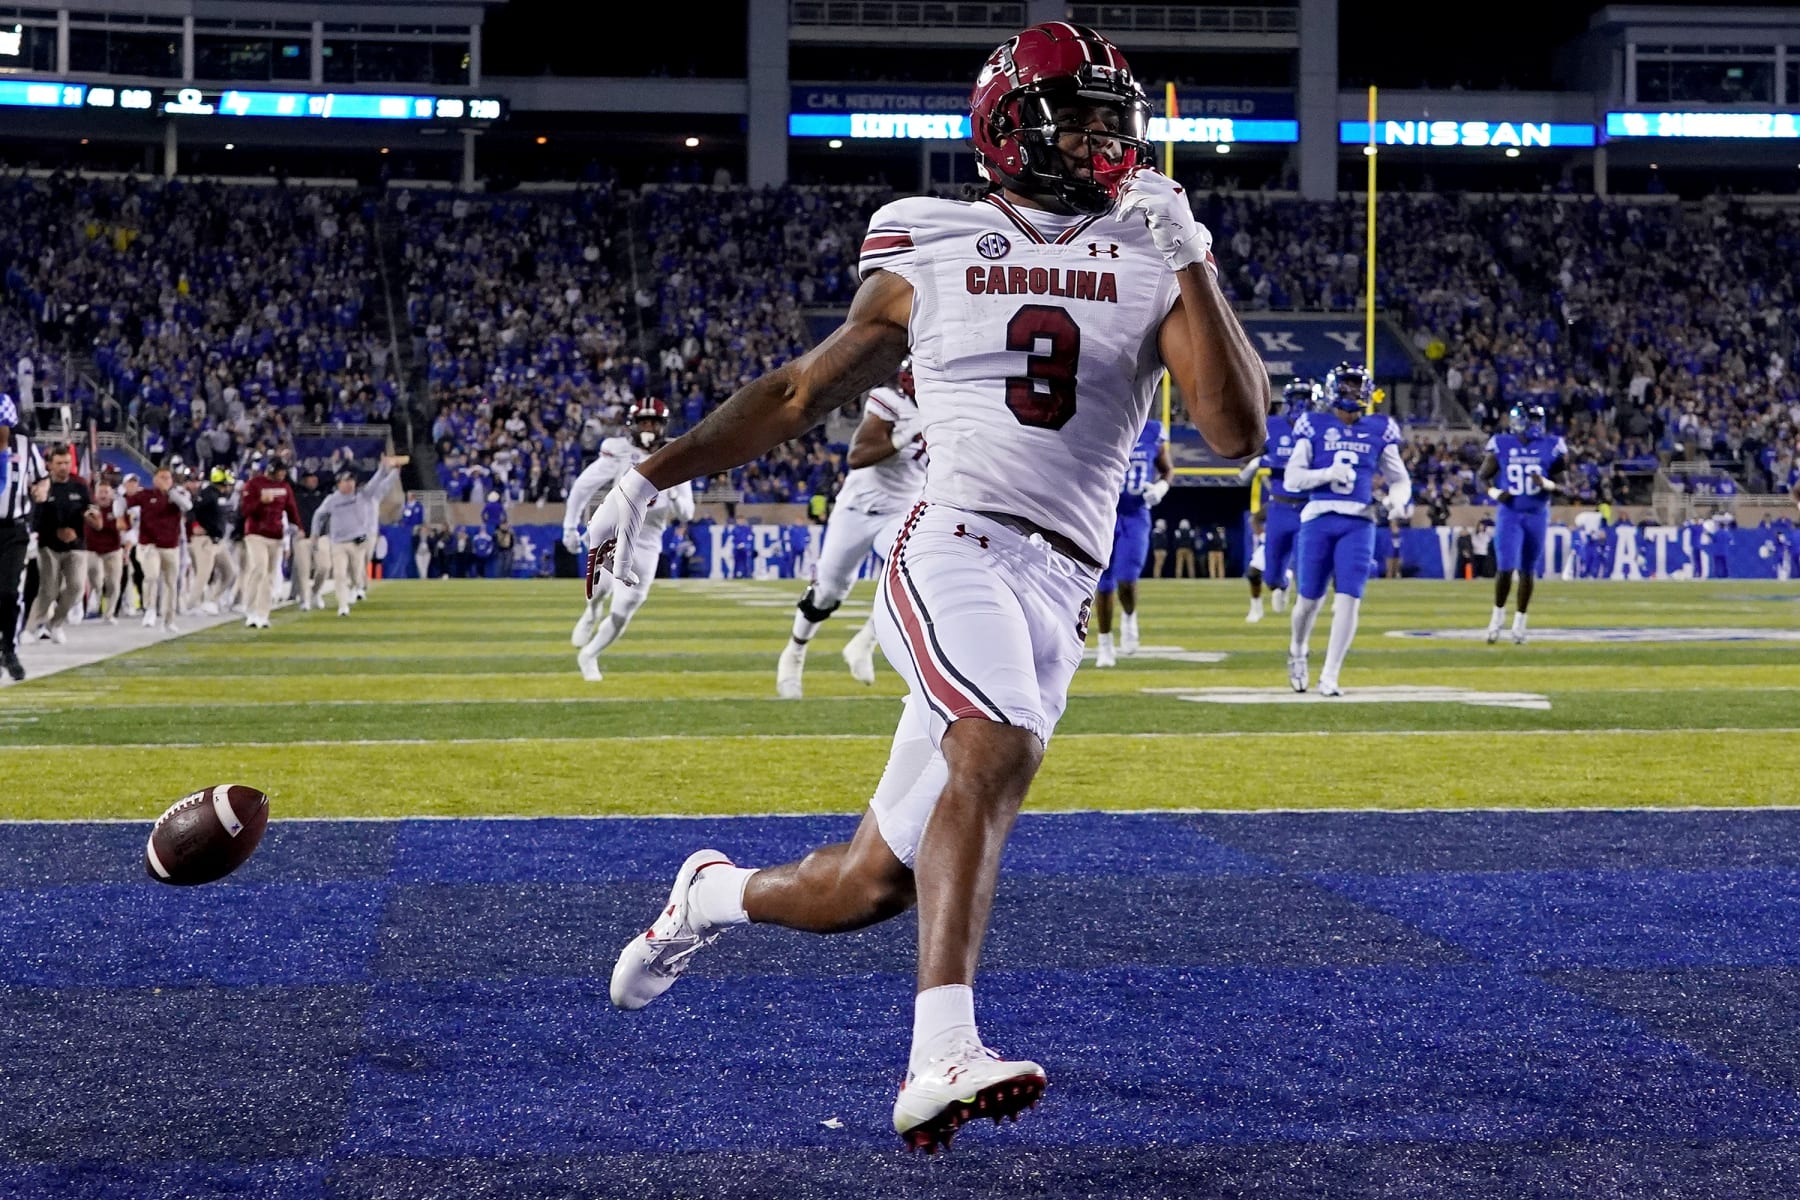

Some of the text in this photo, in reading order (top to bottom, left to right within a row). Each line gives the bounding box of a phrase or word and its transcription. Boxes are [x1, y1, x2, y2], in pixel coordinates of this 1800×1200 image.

[845, 94, 922, 109] NEWTON
[923, 95, 972, 110] GROU
[1206, 99, 1256, 114] FIELD
[851, 113, 964, 139] KENTUCKY
[1147, 117, 1235, 142] ILDCATS
[1384, 120, 1551, 147] NISSAN
[976, 232, 1010, 260] SEC
[965, 265, 1118, 303] CAROLINA
[1004, 303, 1081, 431] 3
